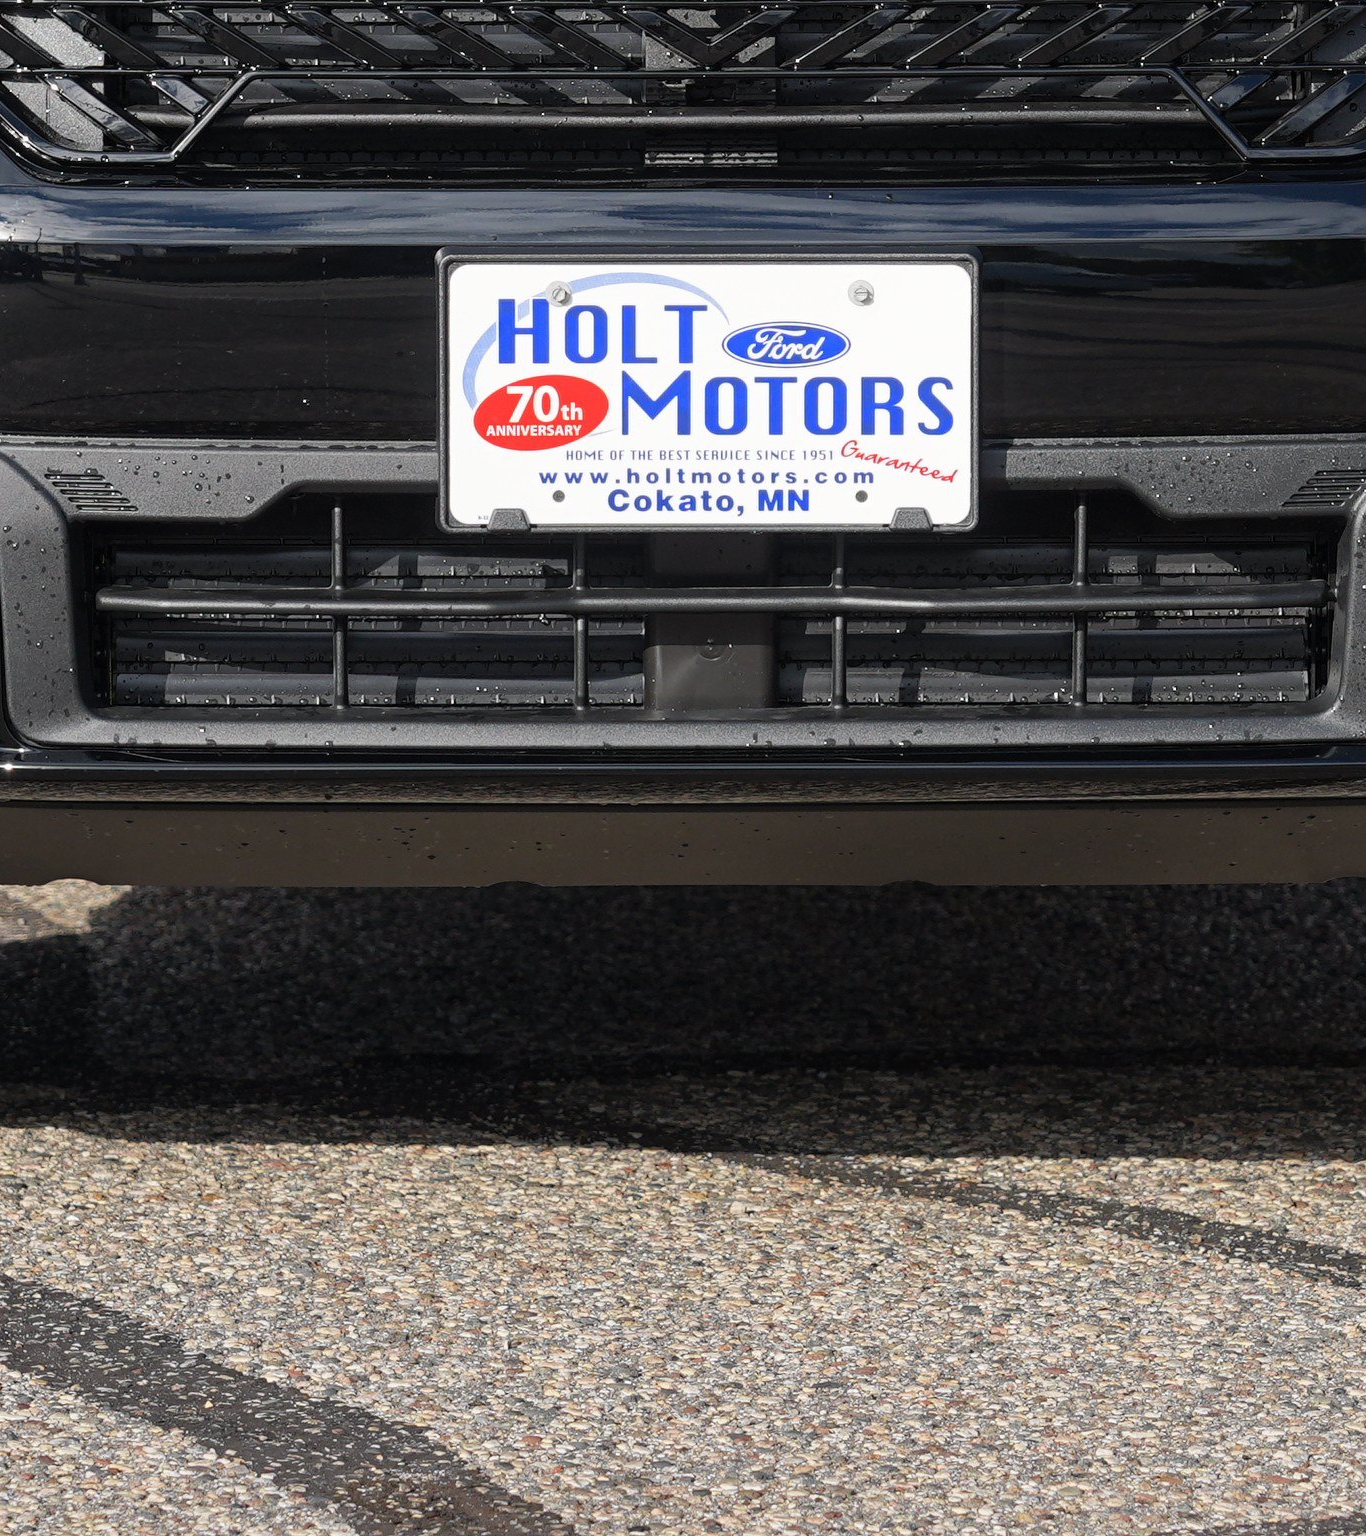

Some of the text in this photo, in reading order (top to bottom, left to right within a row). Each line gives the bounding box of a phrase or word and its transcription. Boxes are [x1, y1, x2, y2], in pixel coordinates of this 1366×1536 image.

[498, 298, 708, 364] HOLT
[747, 328, 825, 360] Ford
[506, 384, 584, 423] 70th
[621, 370, 954, 436] MOTORS
[486, 424, 582, 437] ANNIVERSARY
[566, 450, 834, 461] HOME OF THE BEST SERVICE SINCE 1951
[841, 439, 958, 483] Guaranteed
[539, 467, 875, 485] www.holtmotors.com
[607, 489, 811, 516] Cokato, MN
